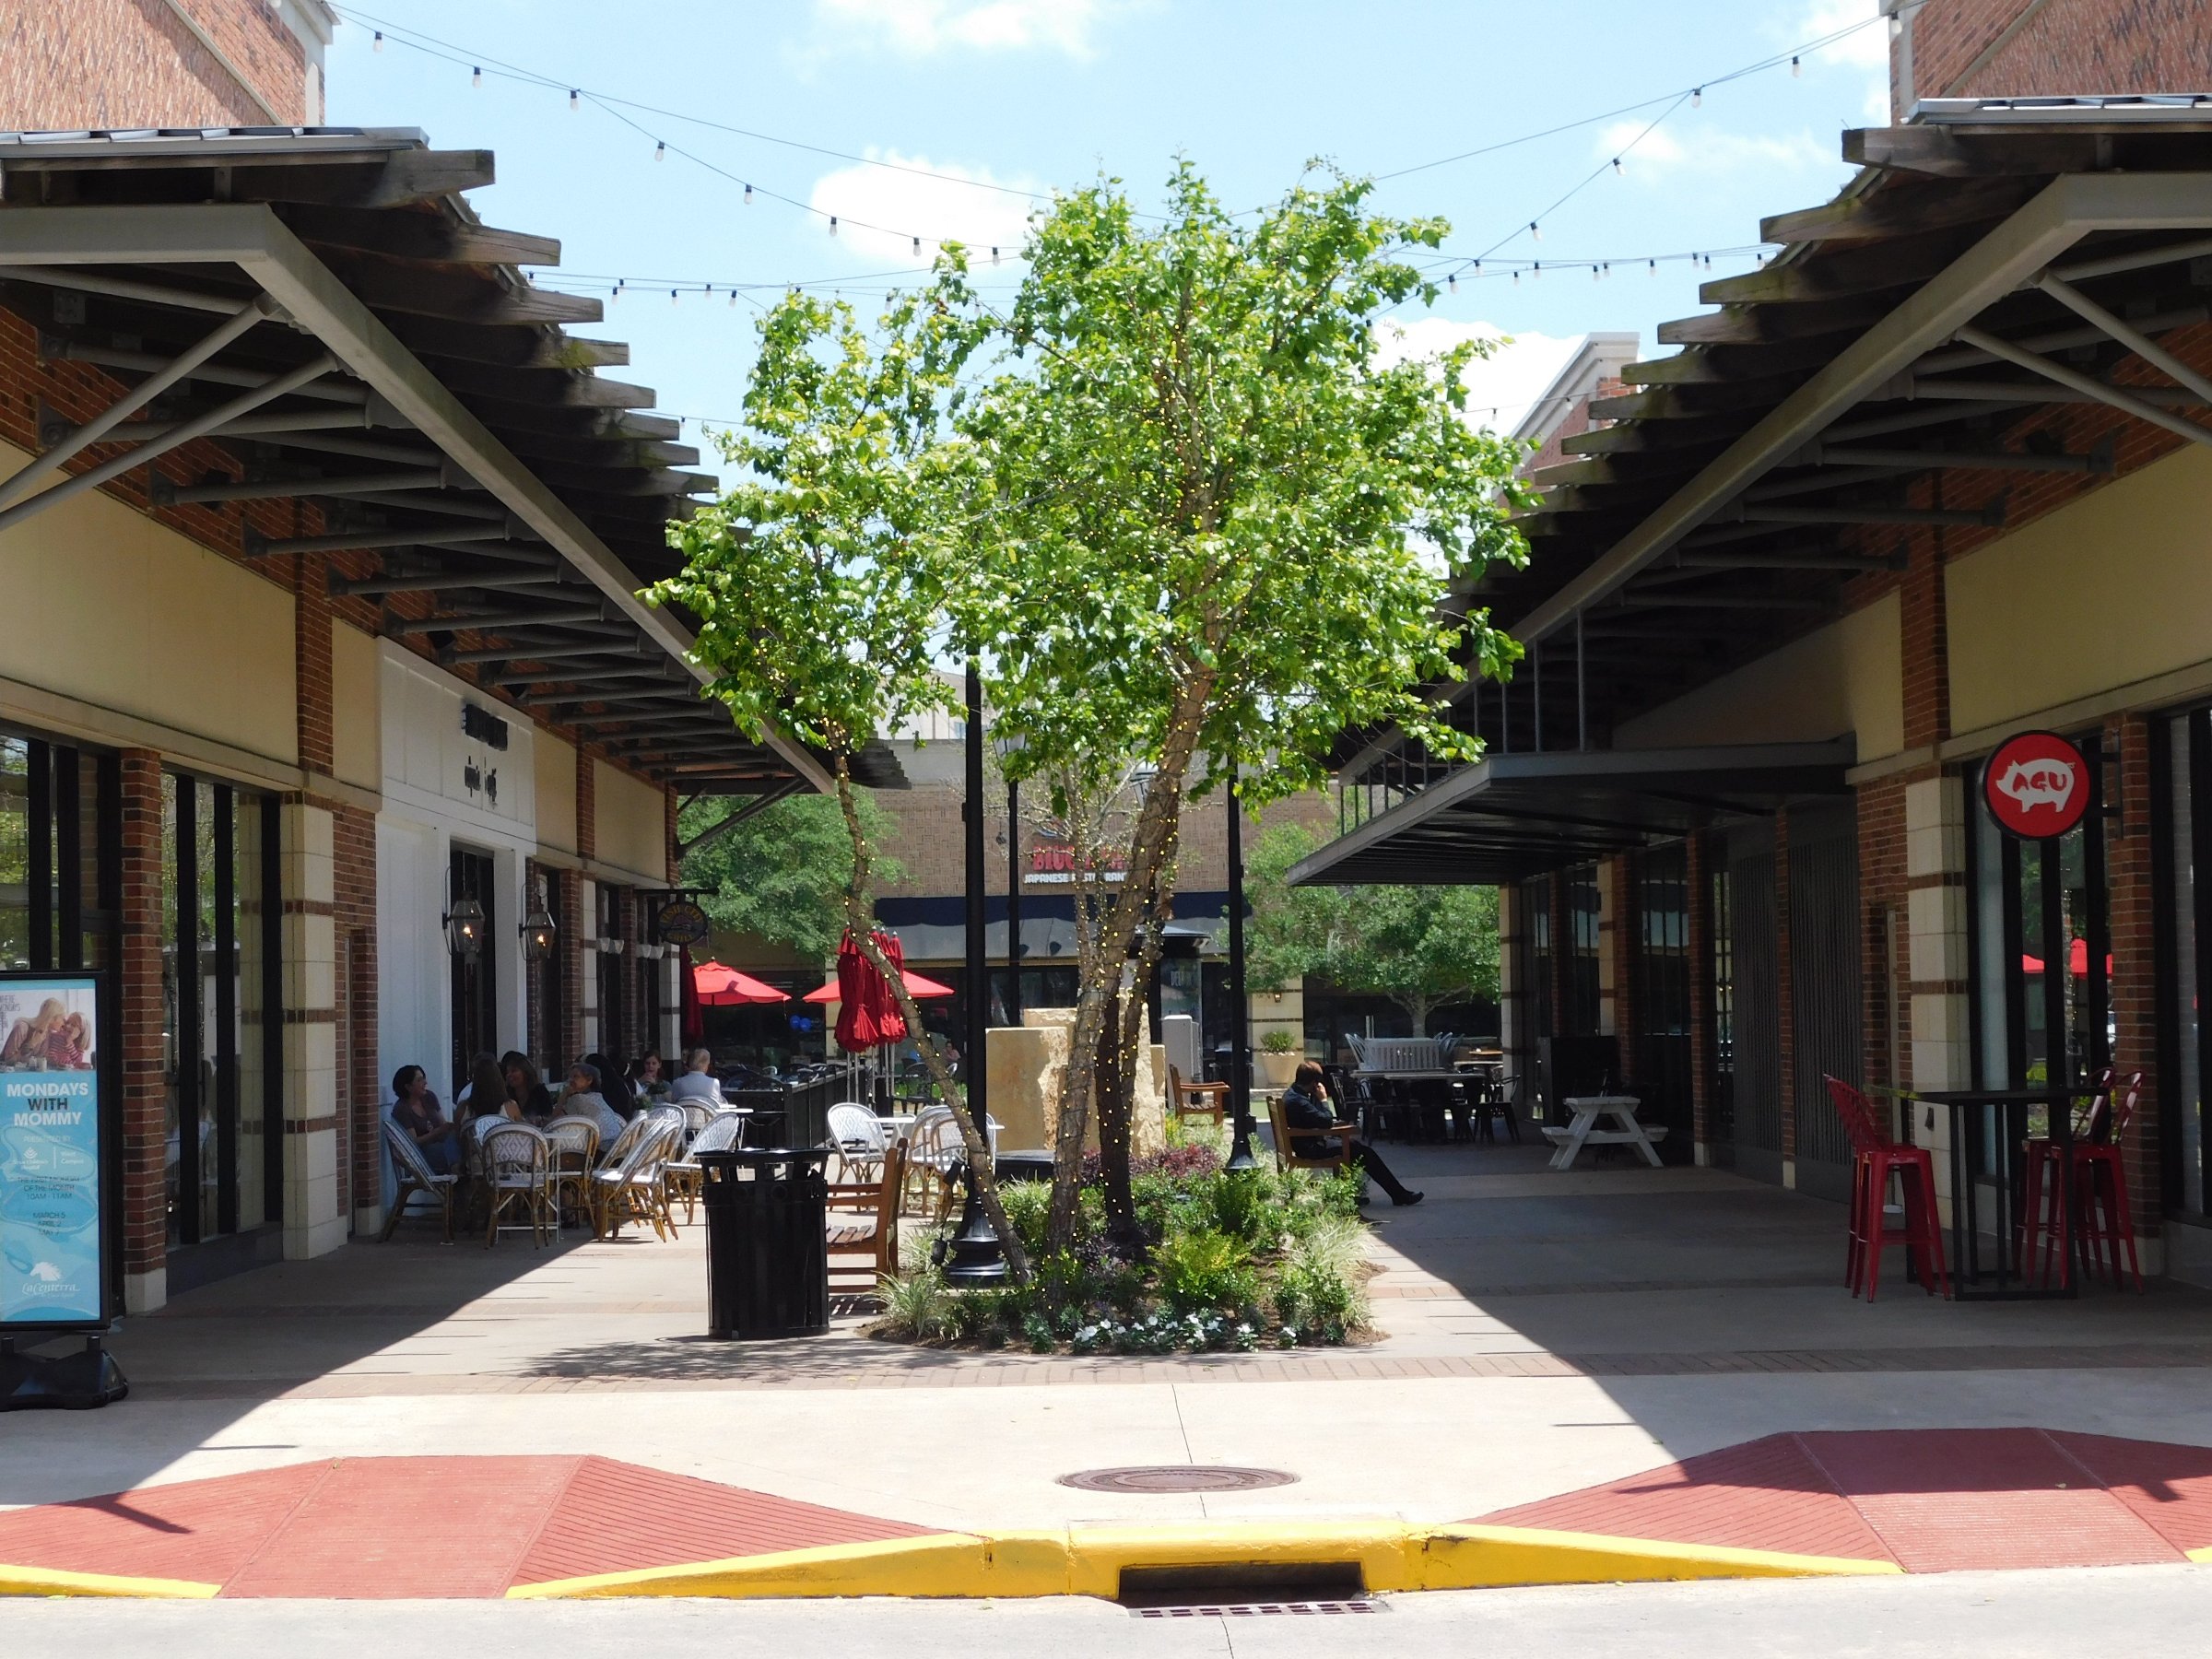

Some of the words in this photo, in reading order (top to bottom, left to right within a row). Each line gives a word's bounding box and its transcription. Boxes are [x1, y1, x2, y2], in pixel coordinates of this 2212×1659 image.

[2012, 771, 2067, 793] AGU
[1024, 873, 1068, 884] JAPANESE
[6, 1083, 88, 1097] MONDAYS
[28, 1098, 68, 1111] WITH
[14, 1112, 82, 1126] MOMMY
